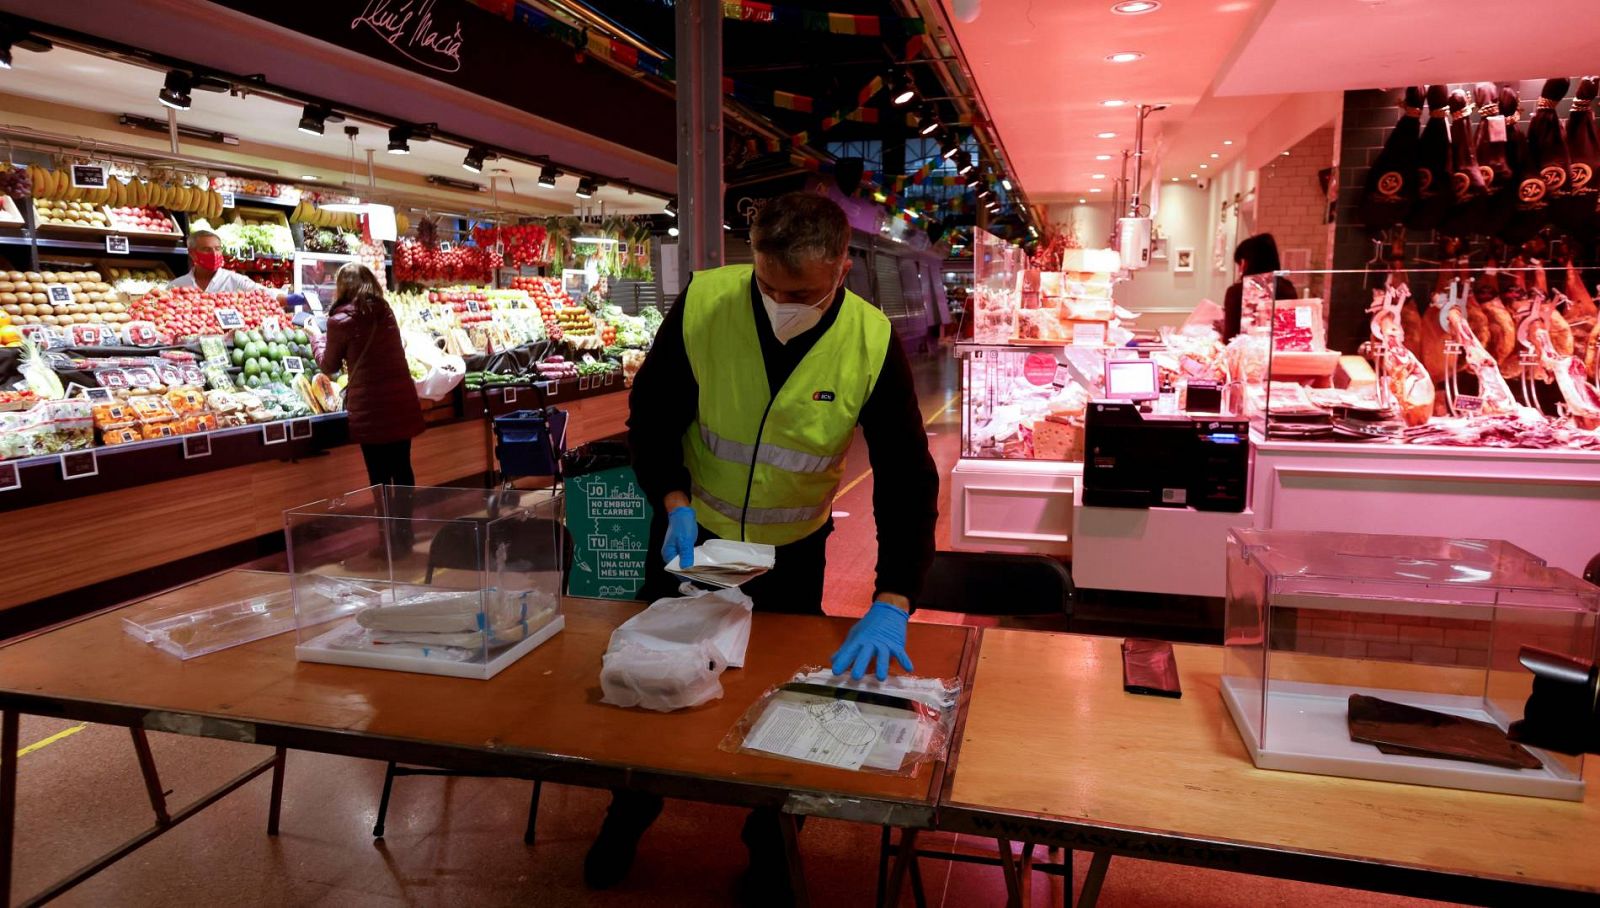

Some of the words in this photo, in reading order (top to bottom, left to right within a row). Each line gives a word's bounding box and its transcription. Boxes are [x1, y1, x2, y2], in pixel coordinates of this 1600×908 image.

[408, 0, 464, 58] Macià
[590, 486, 603, 497] JO
[591, 508, 601, 516] EL
[591, 538, 605, 547] TU
[601, 568, 618, 577] MÉS
[620, 569, 639, 577] NETA
